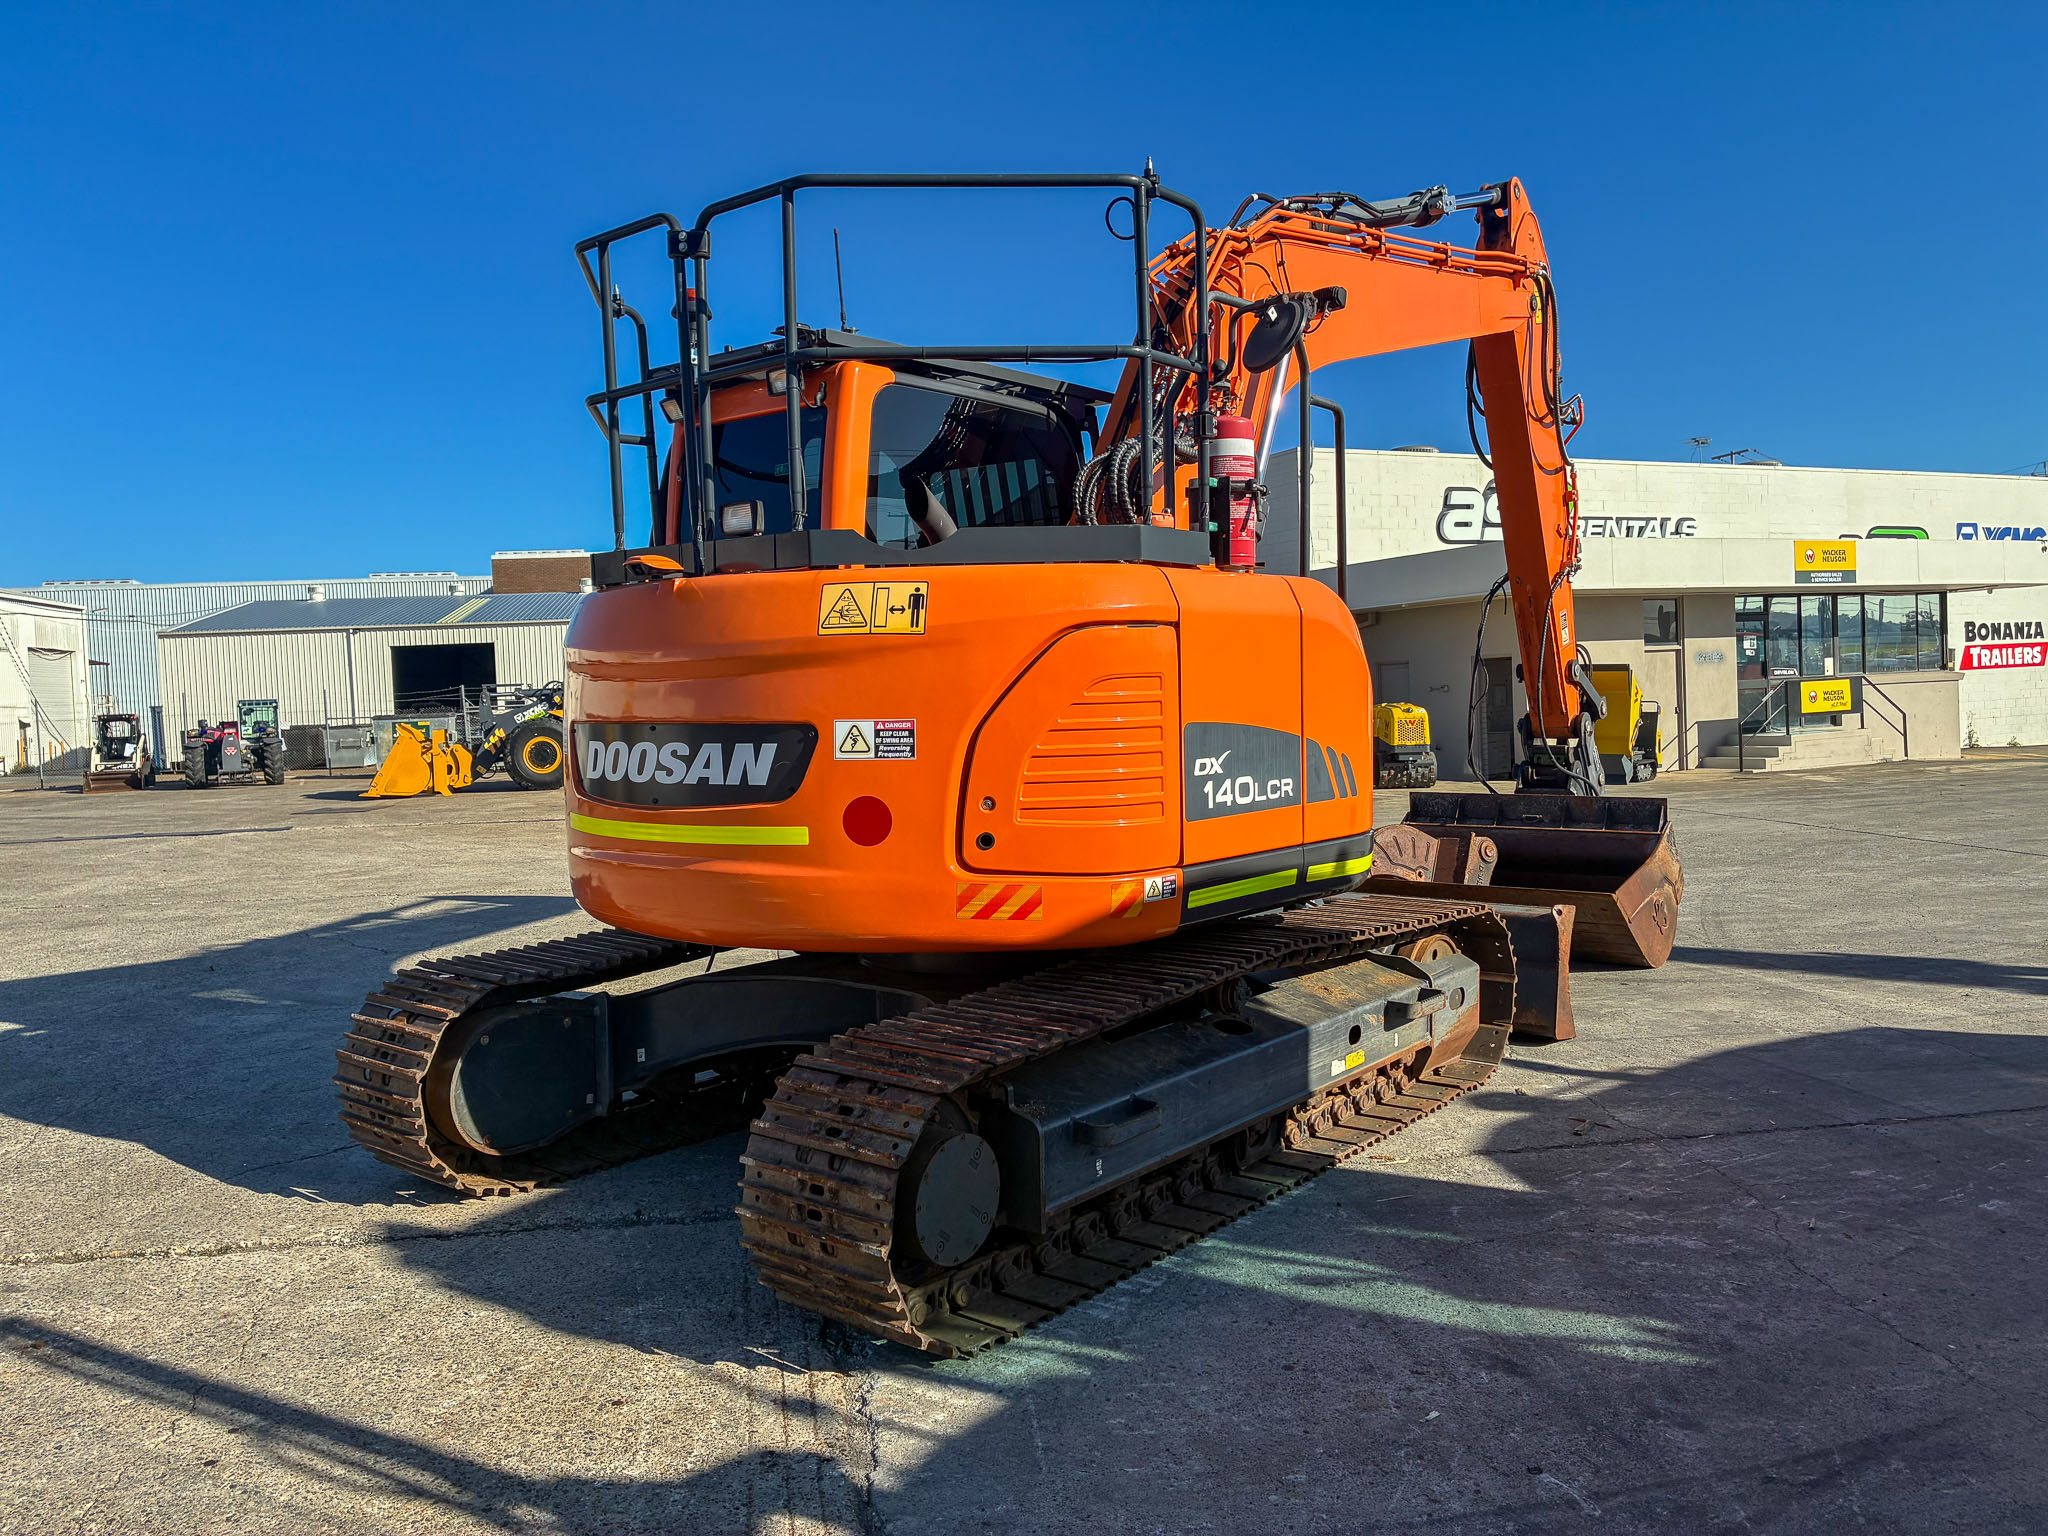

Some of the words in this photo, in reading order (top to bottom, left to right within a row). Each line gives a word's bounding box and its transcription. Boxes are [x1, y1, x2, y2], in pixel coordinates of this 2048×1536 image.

[1570, 517, 1697, 538] RENTALS
[1964, 621, 2045, 642] BONANZA
[1969, 646, 2042, 668] TRAILERS
[586, 740, 778, 786] DOOSAN
[1194, 750, 1232, 776] DX
